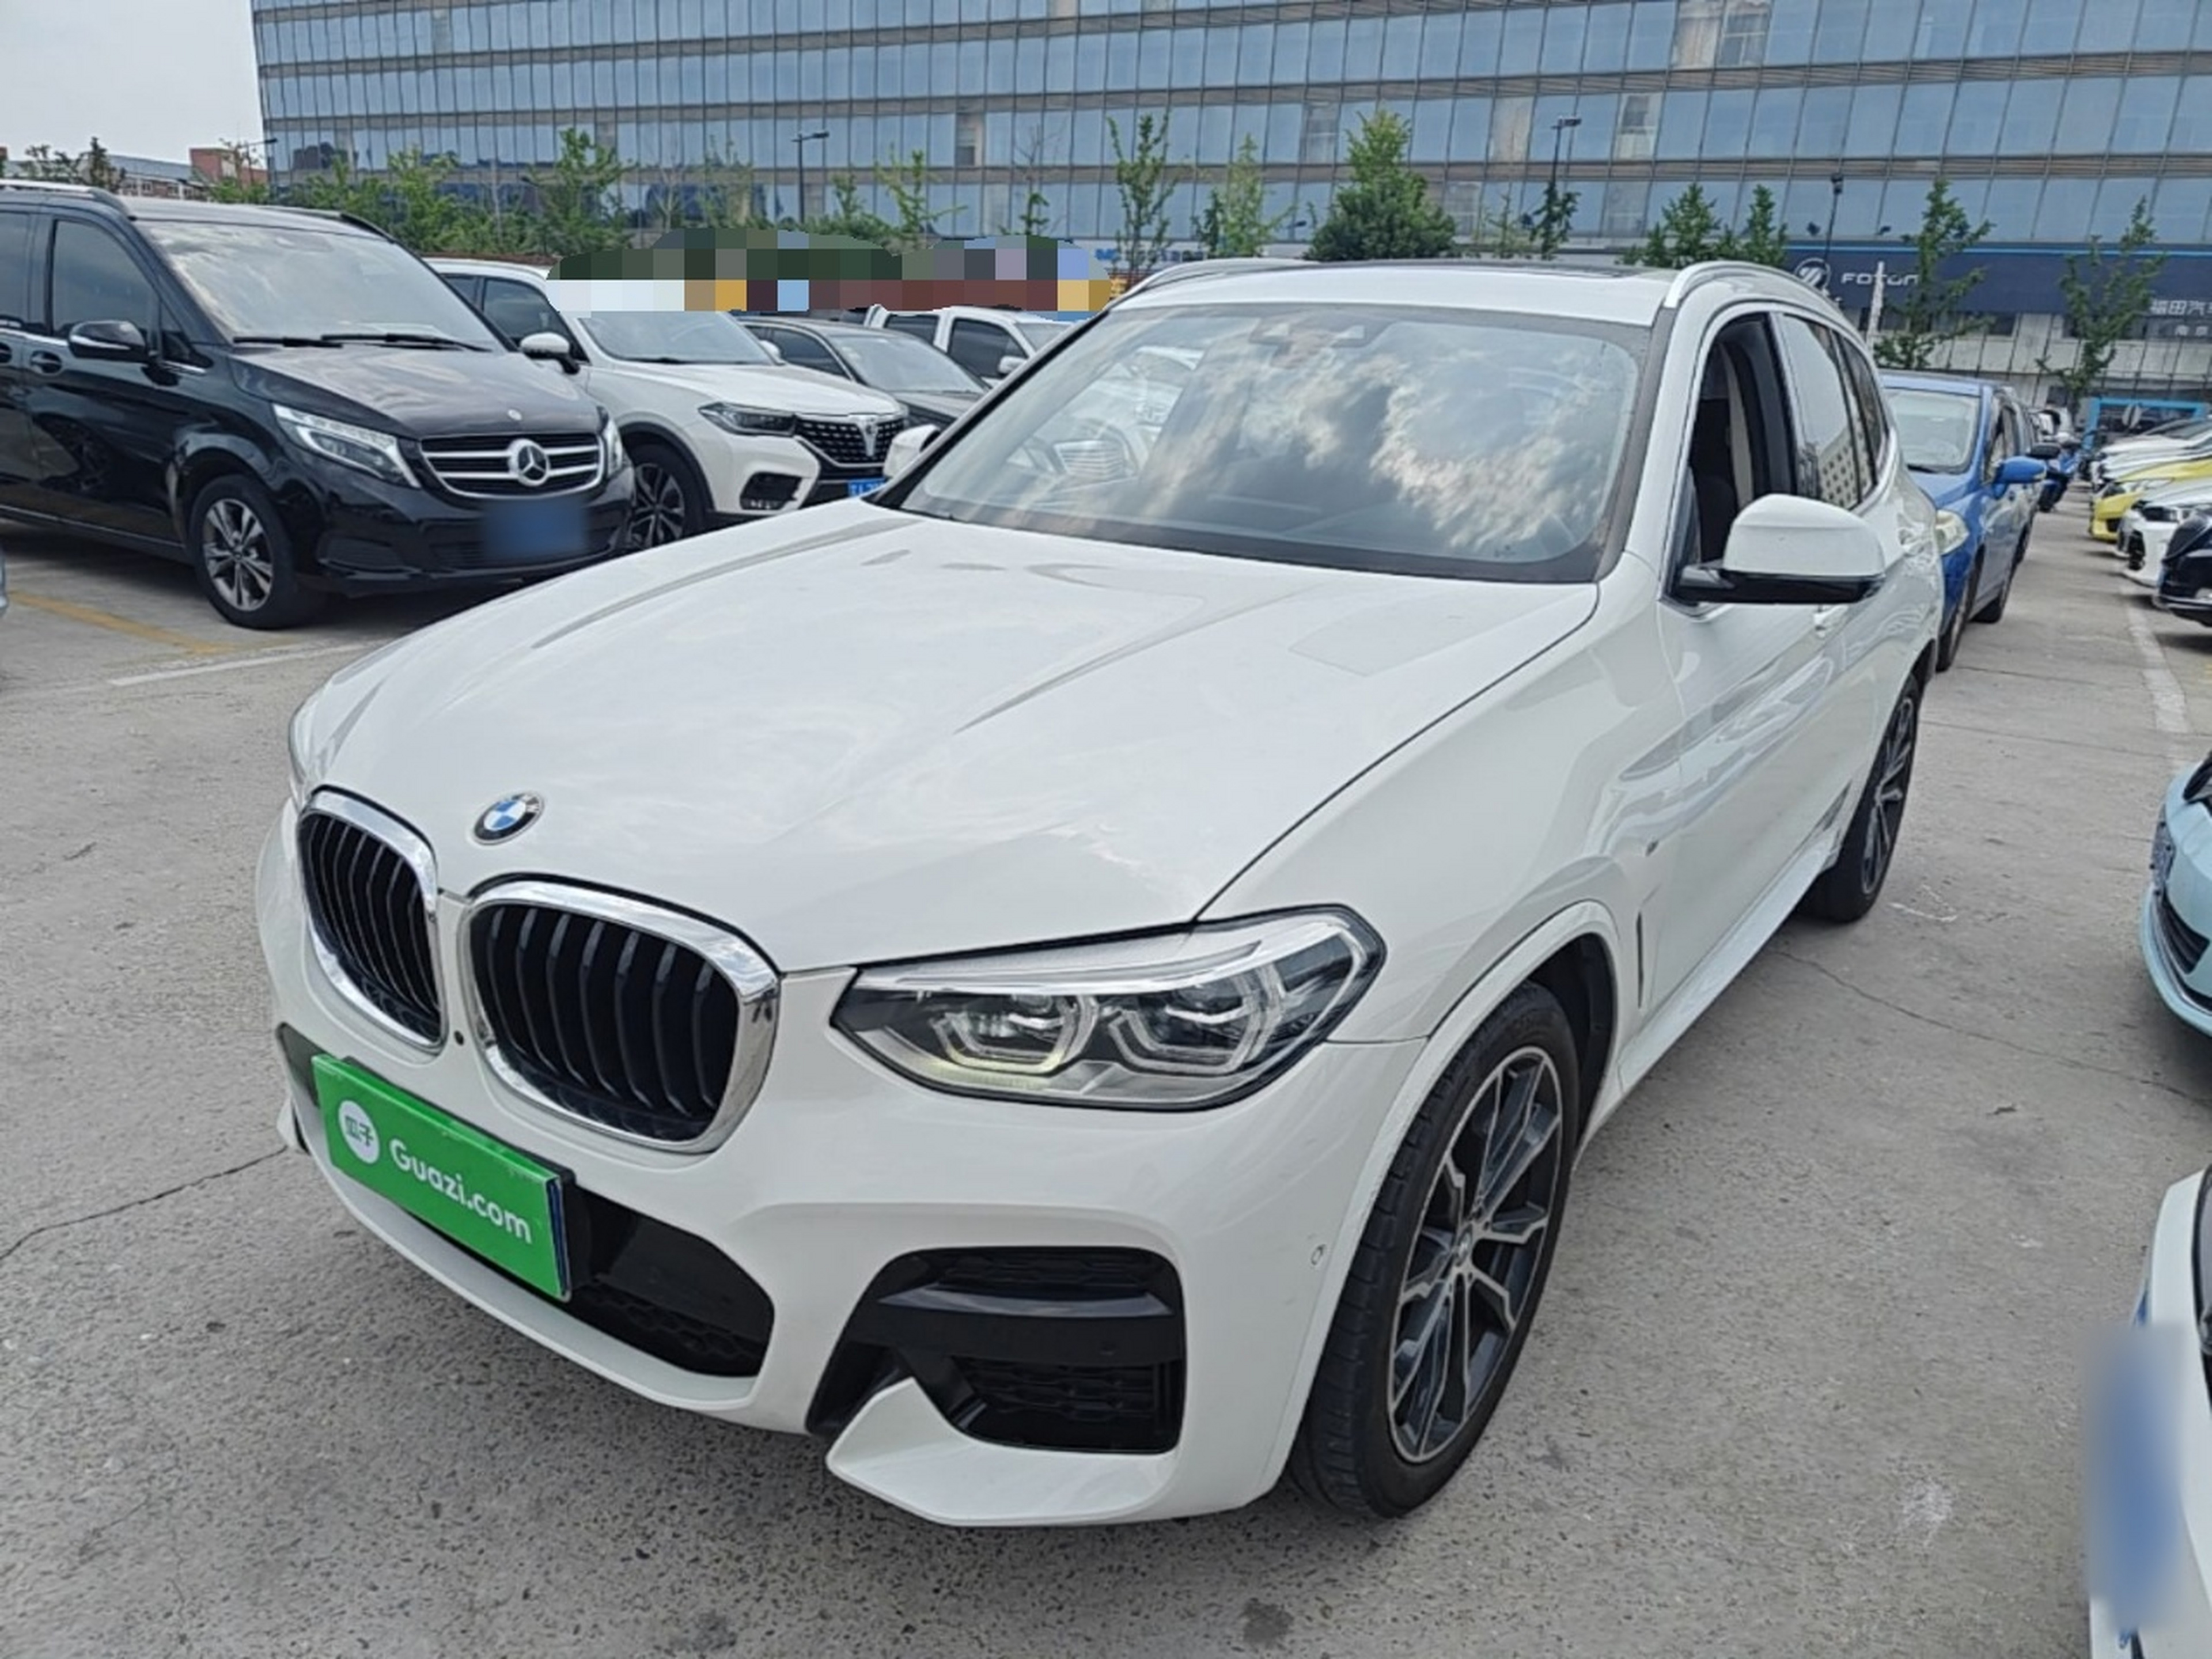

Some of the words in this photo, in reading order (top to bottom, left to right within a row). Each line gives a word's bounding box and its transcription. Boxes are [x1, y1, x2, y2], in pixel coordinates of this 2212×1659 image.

[2150, 299, 2212, 316] 福田汽
[389, 1139, 532, 1244] Guazi.com
